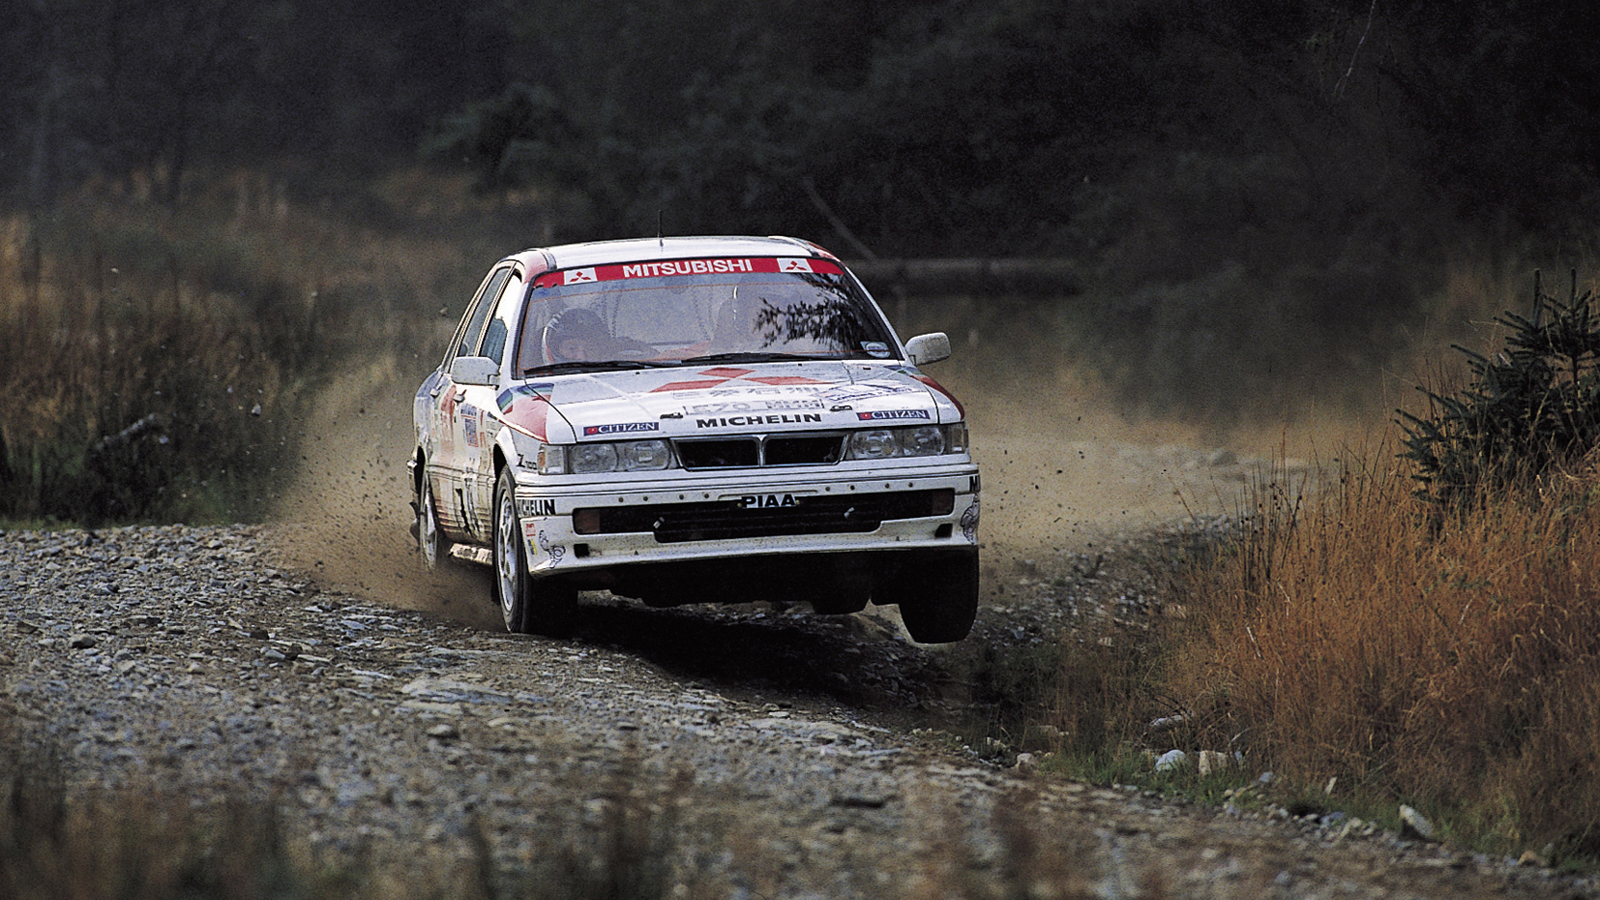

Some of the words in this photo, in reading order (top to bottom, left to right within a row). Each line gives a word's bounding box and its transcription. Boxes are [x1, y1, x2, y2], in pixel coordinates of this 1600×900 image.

[622, 259, 753, 277] MITSUBISHI
[696, 414, 822, 428] MICHELIN
[871, 410, 926, 419] CITIZEN
[598, 422, 655, 434] CITIZEN
[741, 494, 796, 508] PIAA
